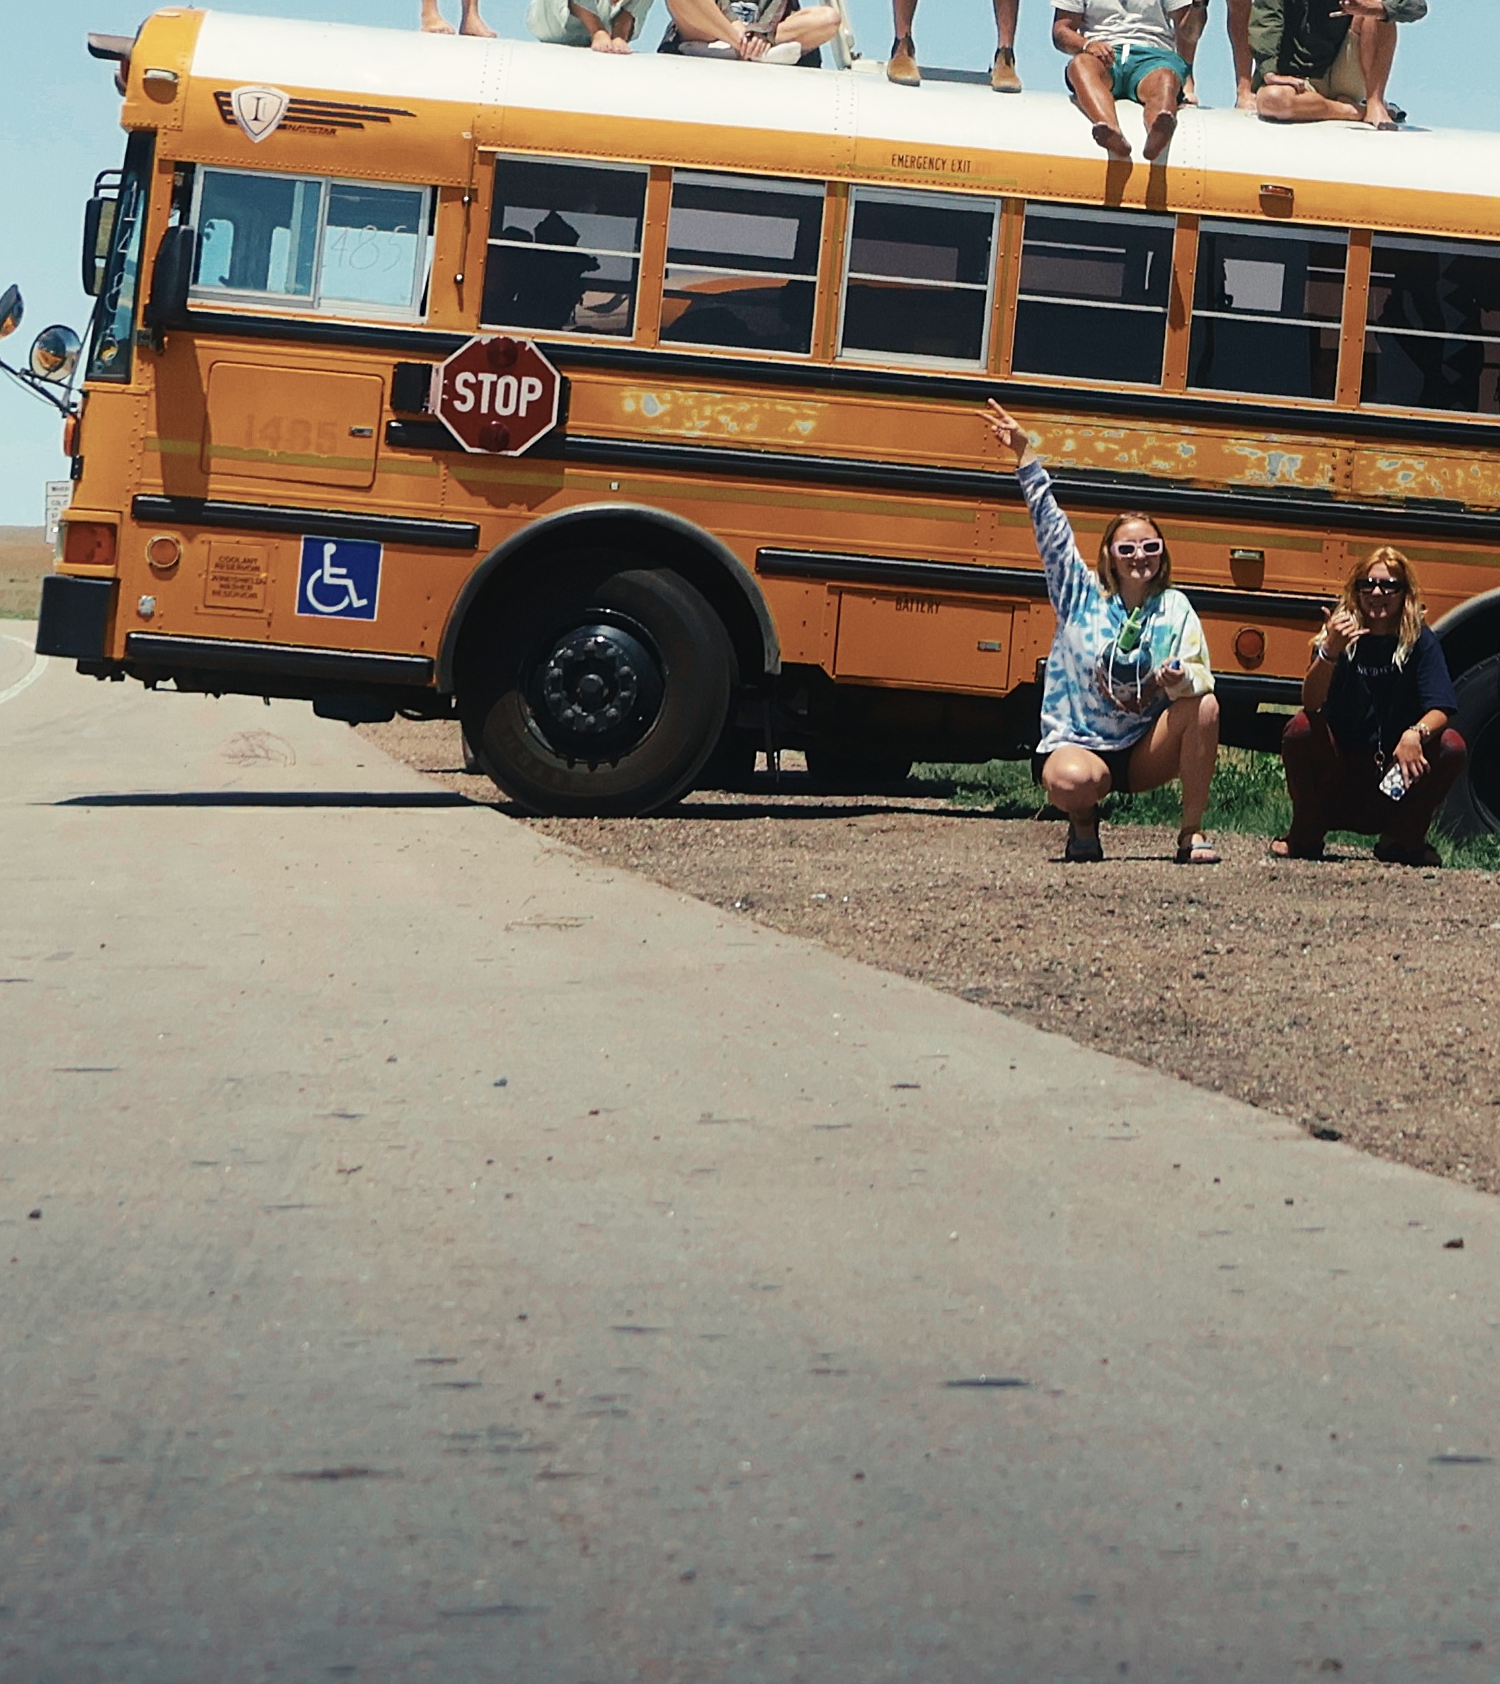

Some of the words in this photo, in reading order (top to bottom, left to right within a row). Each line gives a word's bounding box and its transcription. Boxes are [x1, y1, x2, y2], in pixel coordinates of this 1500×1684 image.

[890, 153, 947, 171] EMERGENCY
[950, 158, 972, 174] EXIT
[453, 371, 543, 418] STOP
[895, 597, 941, 615] BATTERY
